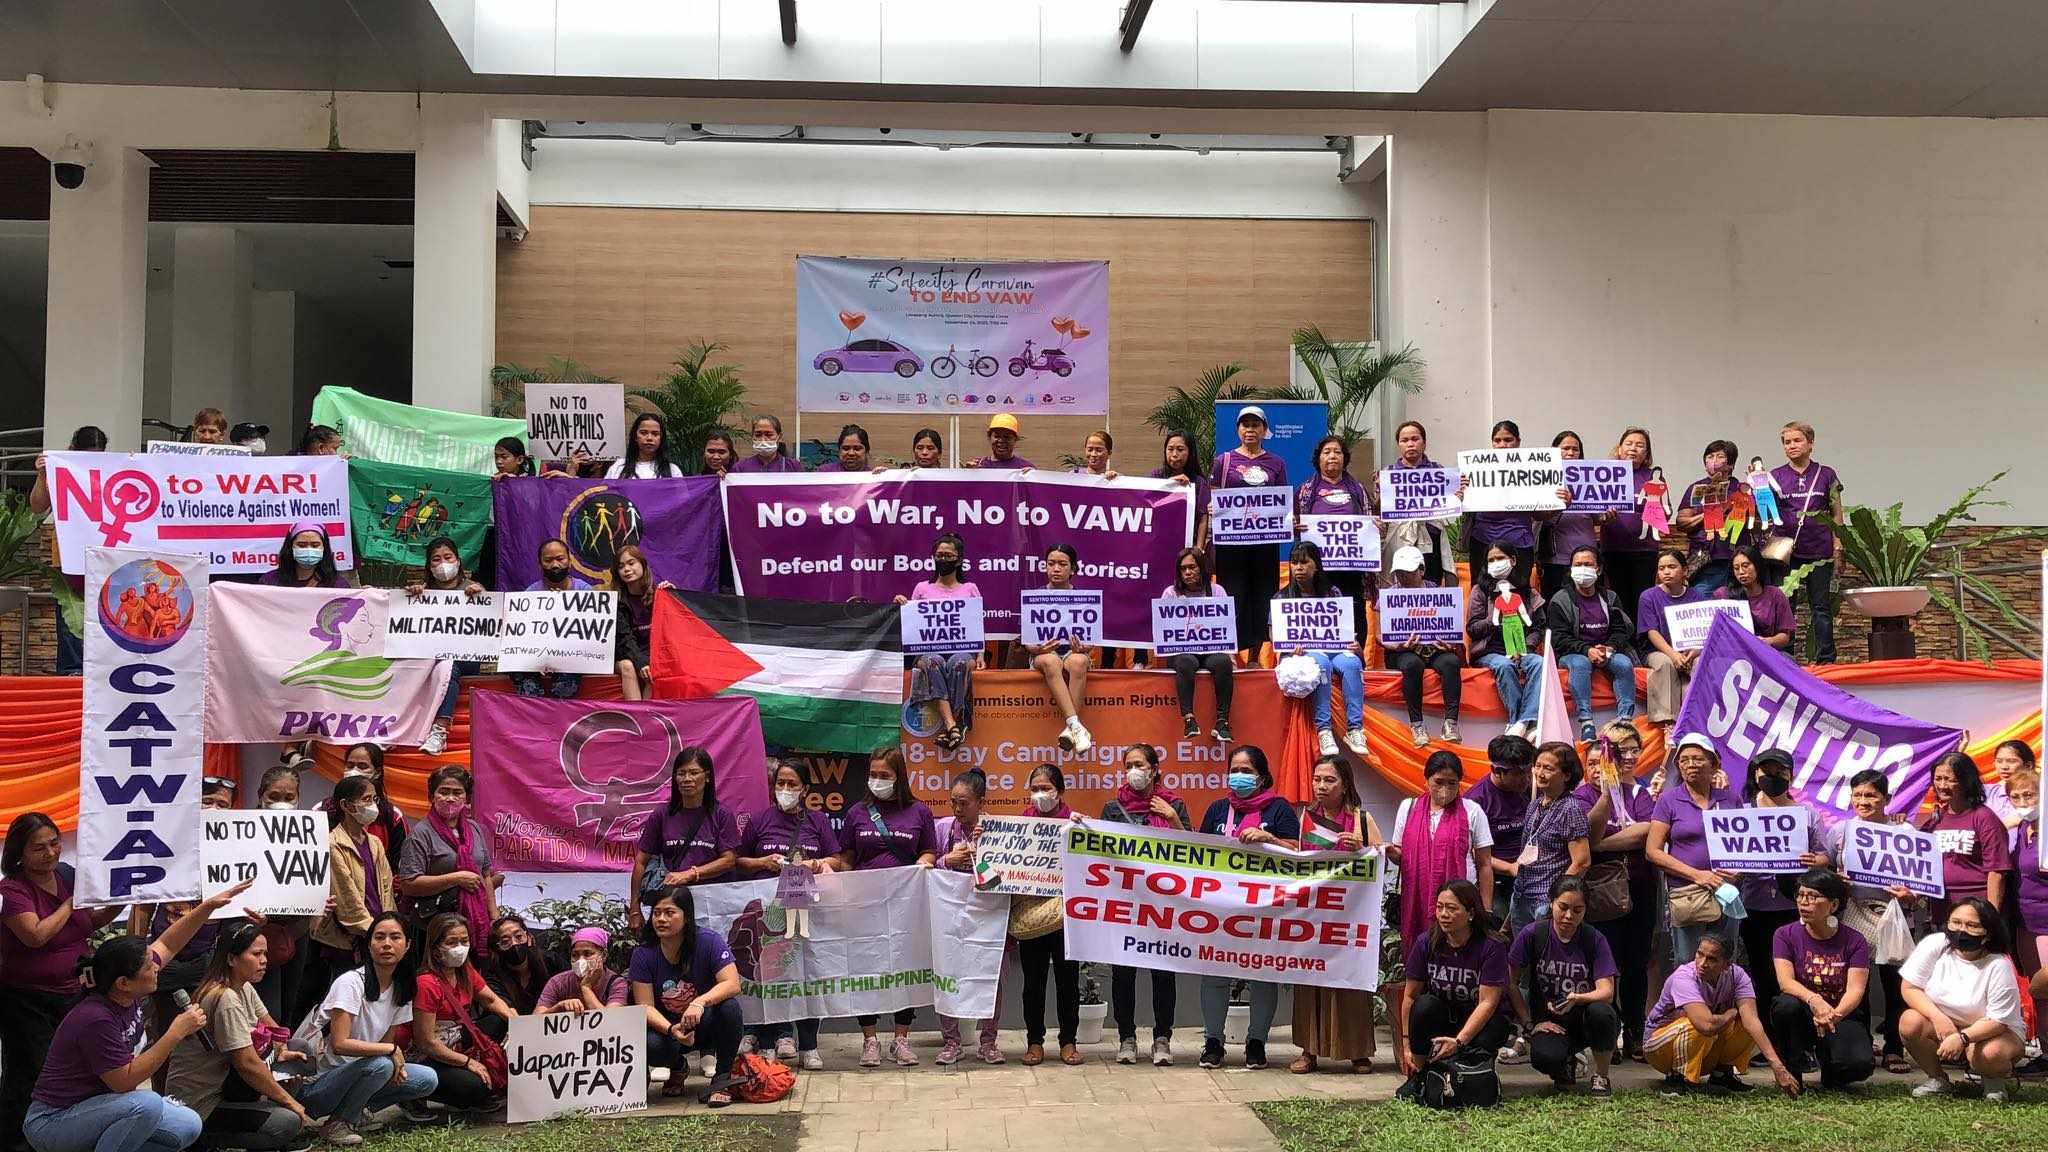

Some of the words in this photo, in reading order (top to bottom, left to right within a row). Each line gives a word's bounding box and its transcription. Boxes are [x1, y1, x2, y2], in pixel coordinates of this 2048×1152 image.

[966, 268, 1034, 292] Caravan
[911, 291, 938, 303] TO
[941, 291, 980, 304] END
[986, 292, 1034, 304] VAW
[550, 396, 568, 410] NO
[572, 396, 587, 410] TO
[528, 413, 604, 440] JAPAN-PHILS
[546, 441, 607, 456] VFA!
[1464, 453, 1500, 465] TAMA
[1506, 452, 1521, 463] NA
[1528, 452, 1552, 463] ANG
[1390, 471, 1450, 486] BIGAS,
[1565, 466, 1627, 483] STOP
[167, 475, 203, 494] to
[216, 474, 318, 494] WAR!
[1395, 485, 1445, 497] HINDI
[1567, 484, 1627, 501] VAW!
[162, 503, 174, 518] to
[177, 499, 235, 518] Violence
[237, 501, 286, 521] Against
[290, 498, 341, 517] Women!
[1216, 494, 1286, 508] WOMEN
[1395, 498, 1447, 510] BALA!
[757, 502, 807, 528] No
[819, 502, 856, 525] to
[867, 499, 943, 530] War,
[957, 500, 1005, 525] No
[1017, 501, 1049, 526] to
[1061, 503, 1153, 532] VAW!
[1220, 516, 1284, 530] PEACE!
[1317, 521, 1363, 533] STOP
[1323, 534, 1359, 545] THE
[1317, 546, 1363, 558] WAR!
[761, 555, 843, 576] Defend
[850, 557, 888, 571] our
[894, 555, 970, 572] Bods
[978, 555, 1019, 571] and
[1026, 556, 1149, 580] Tetories!
[406, 594, 438, 606] TAMA
[445, 594, 460, 606] NA
[466, 595, 492, 606] ANG
[509, 598, 529, 612] NO
[537, 596, 554, 611] TO
[562, 592, 611, 614] WAR
[917, 600, 966, 614] STOP
[1281, 601, 1343, 616] BIGAS,
[1387, 594, 1456, 608] KAPAYAPAAN,
[1030, 609, 1062, 624] NO
[1069, 609, 1098, 624] TO
[1158, 604, 1229, 618] WOMEN
[1407, 608, 1437, 616] Hindi
[1675, 606, 1744, 620] KAPAYAAN,
[389, 616, 502, 638] MILITARISMO!
[923, 614, 961, 627] THE
[1287, 615, 1338, 627] HINDI
[1391, 617, 1454, 631] KARAHASAN!
[505, 622, 526, 636] NO
[531, 621, 549, 635] TO
[553, 617, 614, 643] VAW!
[919, 627, 966, 641] WAR!
[1036, 626, 1092, 641] WAR!
[1163, 628, 1228, 642] PEACE!
[1287, 628, 1340, 641] BALA!
[974, 694, 1045, 707] mmission
[1084, 696, 1125, 707] uman
[1130, 694, 1178, 708] Rights
[279, 711, 400, 738] PKKK
[1707, 659, 1914, 812] SENTRO
[1177, 742, 1226, 762] End
[907, 769, 1015, 791] iolce
[206, 821, 228, 840] NO
[233, 821, 256, 839] TO
[260, 815, 317, 845] WAR
[494, 810, 576, 838] Women
[981, 820, 1030, 835] PERMANENT
[1711, 816, 1750, 833] NO
[1758, 814, 1796, 832] TO
[492, 836, 587, 864] PARTIDO
[979, 835, 1006, 847] NOW!
[1005, 835, 1033, 850] STOP
[1037, 840, 1061, 853] THE
[1721, 836, 1791, 853] WAR!
[1855, 827, 1932, 857] STOP
[982, 850, 1063, 870] GENOCIDE
[1070, 831, 1221, 867] PERMANENT
[1228, 851, 1374, 878] CEASEFIRE!
[207, 864, 231, 883] NO
[234, 862, 257, 881] TO
[264, 849, 329, 886] VAW
[1856, 848, 1933, 881] VAW!
[1085, 863, 1222, 899] STOP
[1238, 882, 1347, 911] THE
[1855, 872, 1881, 883] SENTRO
[1881, 877, 1905, 887] WOMEN
[1065, 896, 1369, 948] GENOCIDE!
[1124, 936, 1192, 958] Partido
[1199, 944, 1326, 972] Manggagawa
[1428, 963, 1481, 985] RATIFY
[1536, 959, 1590, 977] RATIFY
[840, 968, 934, 993] PHILIPPINE
[544, 1015, 571, 1036] NO
[579, 1011, 603, 1030] TO
[509, 1036, 634, 1080] Japan-Phils
[548, 1065, 633, 1099] VFA!
